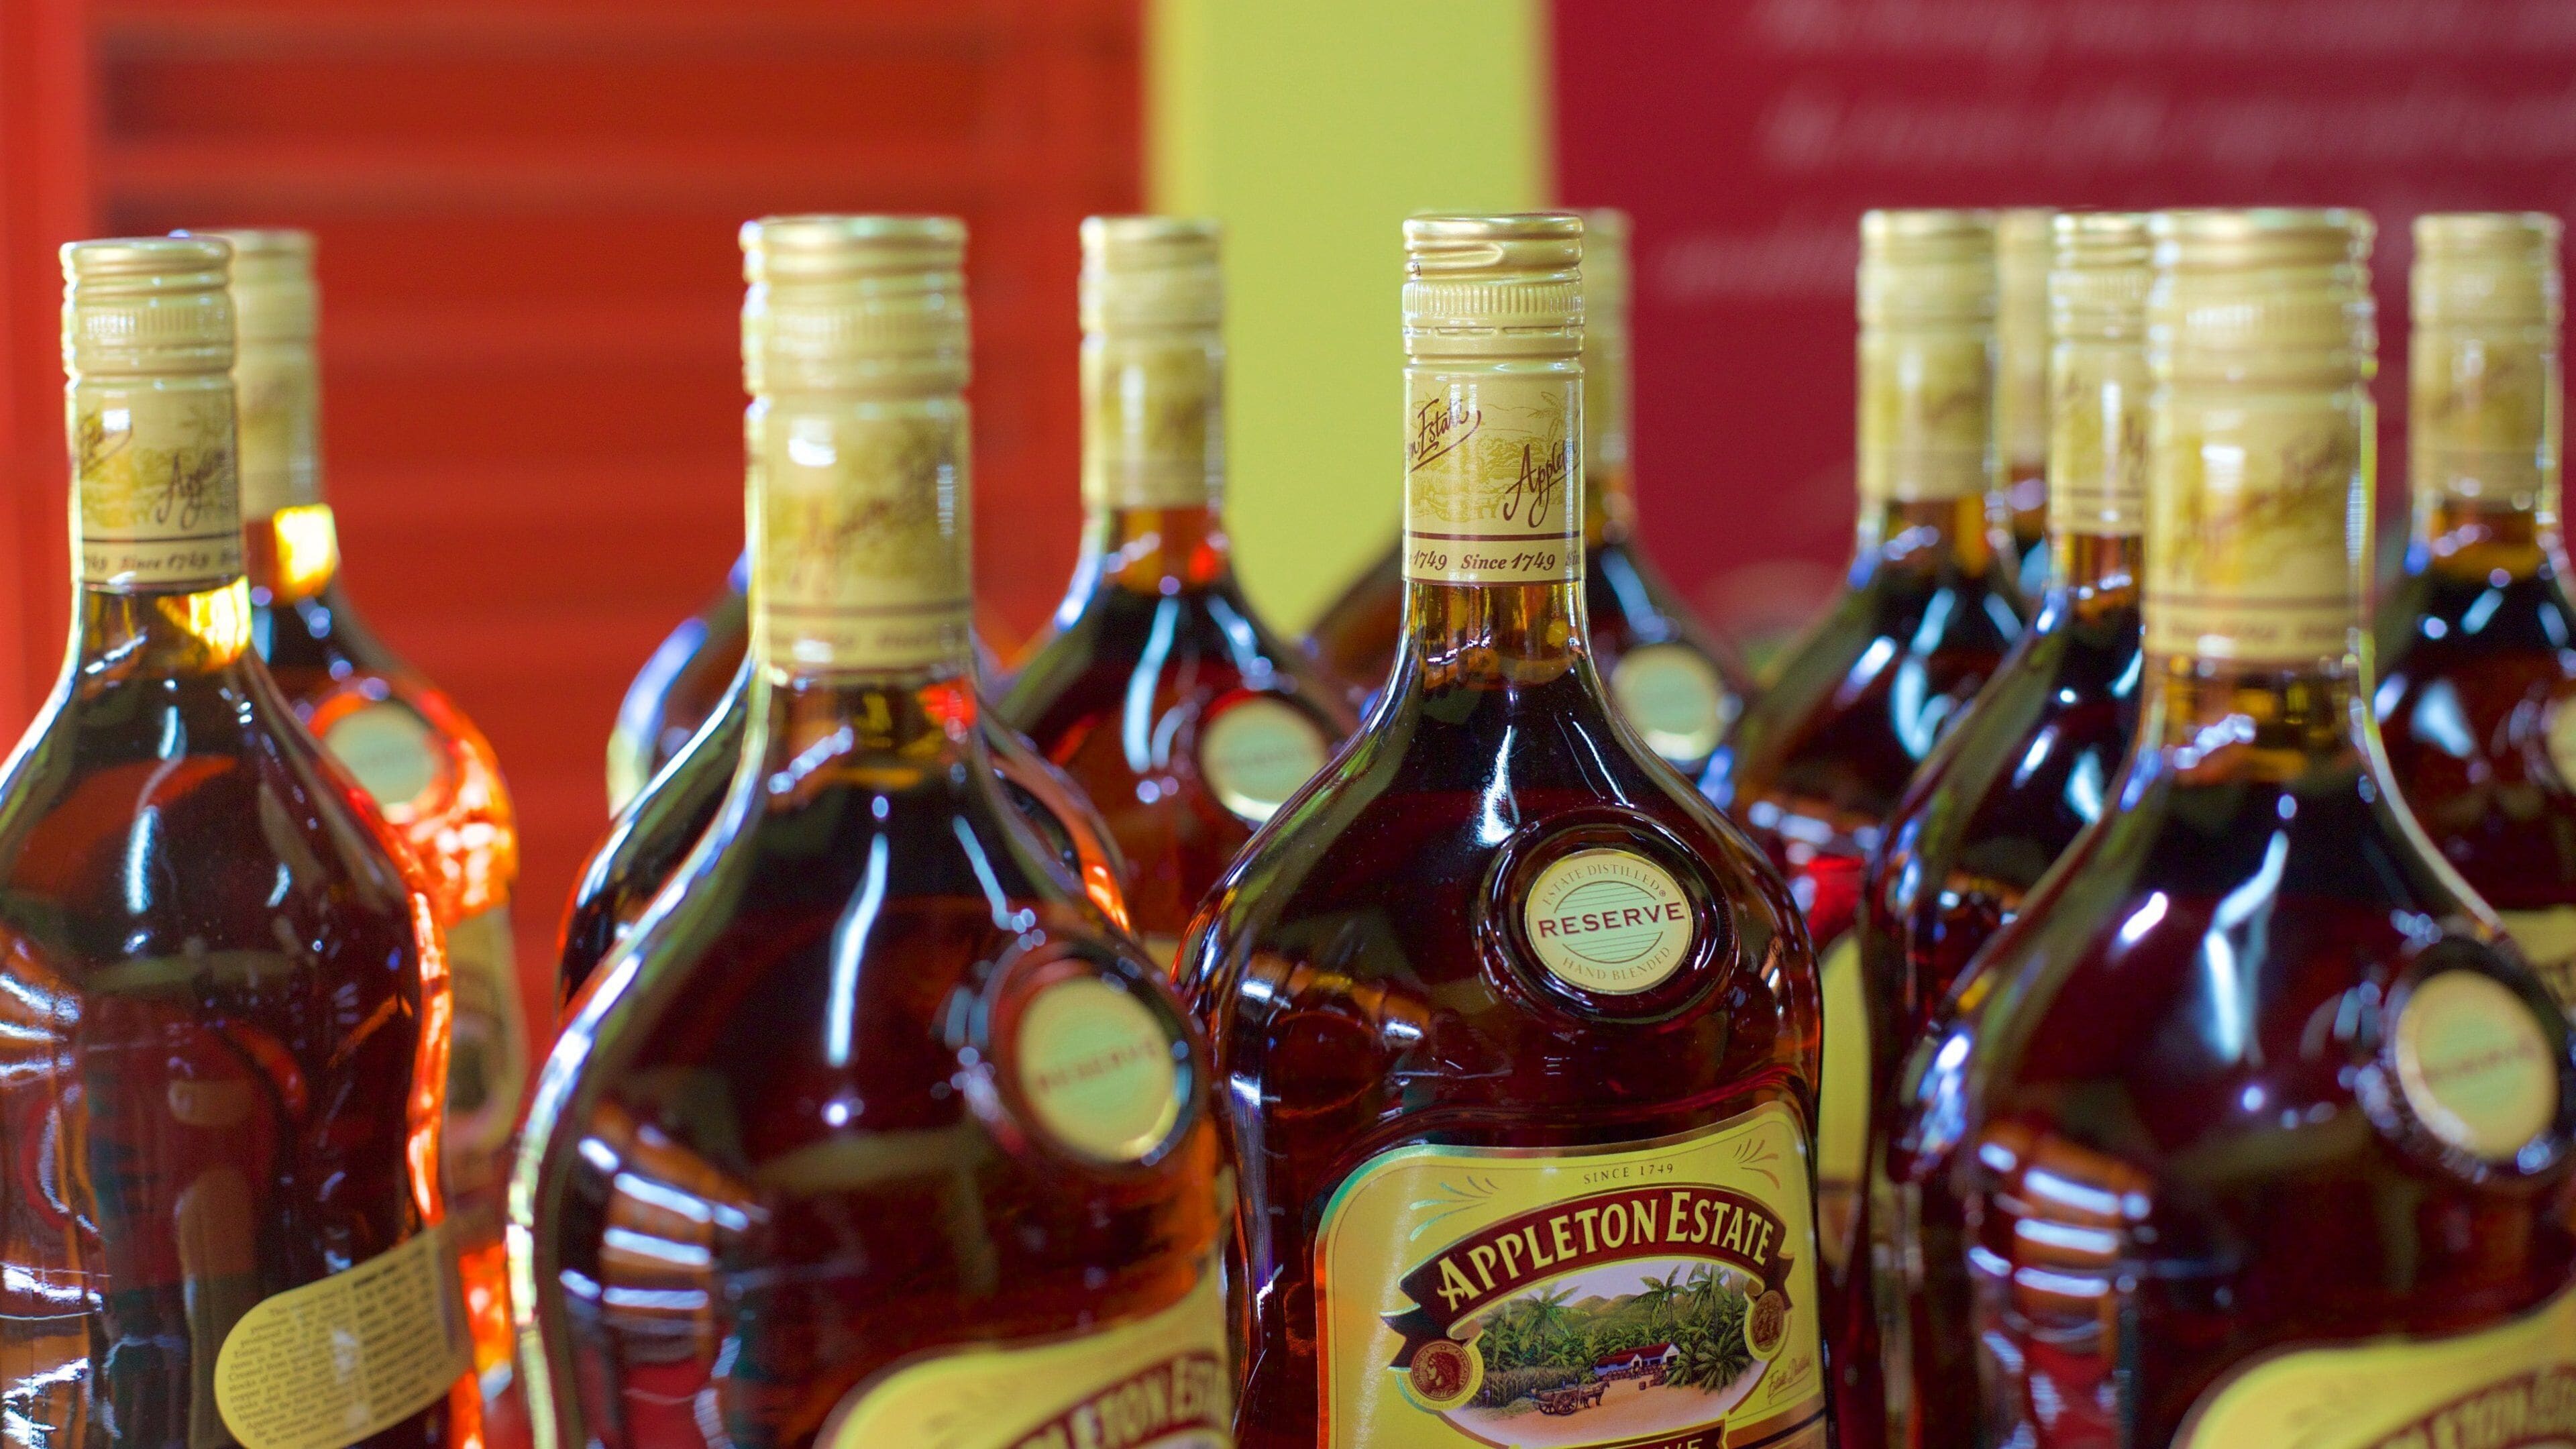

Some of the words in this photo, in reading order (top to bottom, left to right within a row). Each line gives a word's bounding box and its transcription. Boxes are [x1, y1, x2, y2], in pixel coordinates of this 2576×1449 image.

[1413, 549, 1448, 571] 1749
[1460, 553, 1507, 570] Since
[1511, 551, 1556, 572] 1749
[1542, 868, 1584, 906] ESTATE
[1538, 902, 1685, 938] RESERVE
[1562, 957, 1606, 980] HAND
[1612, 947, 1670, 981] BLENDED
[1583, 1167, 1630, 1185] SINCE
[1640, 1163, 1673, 1176] 1749
[1436, 1198, 1658, 1313] APPLETON
[1666, 1191, 1774, 1267] ESTATE
